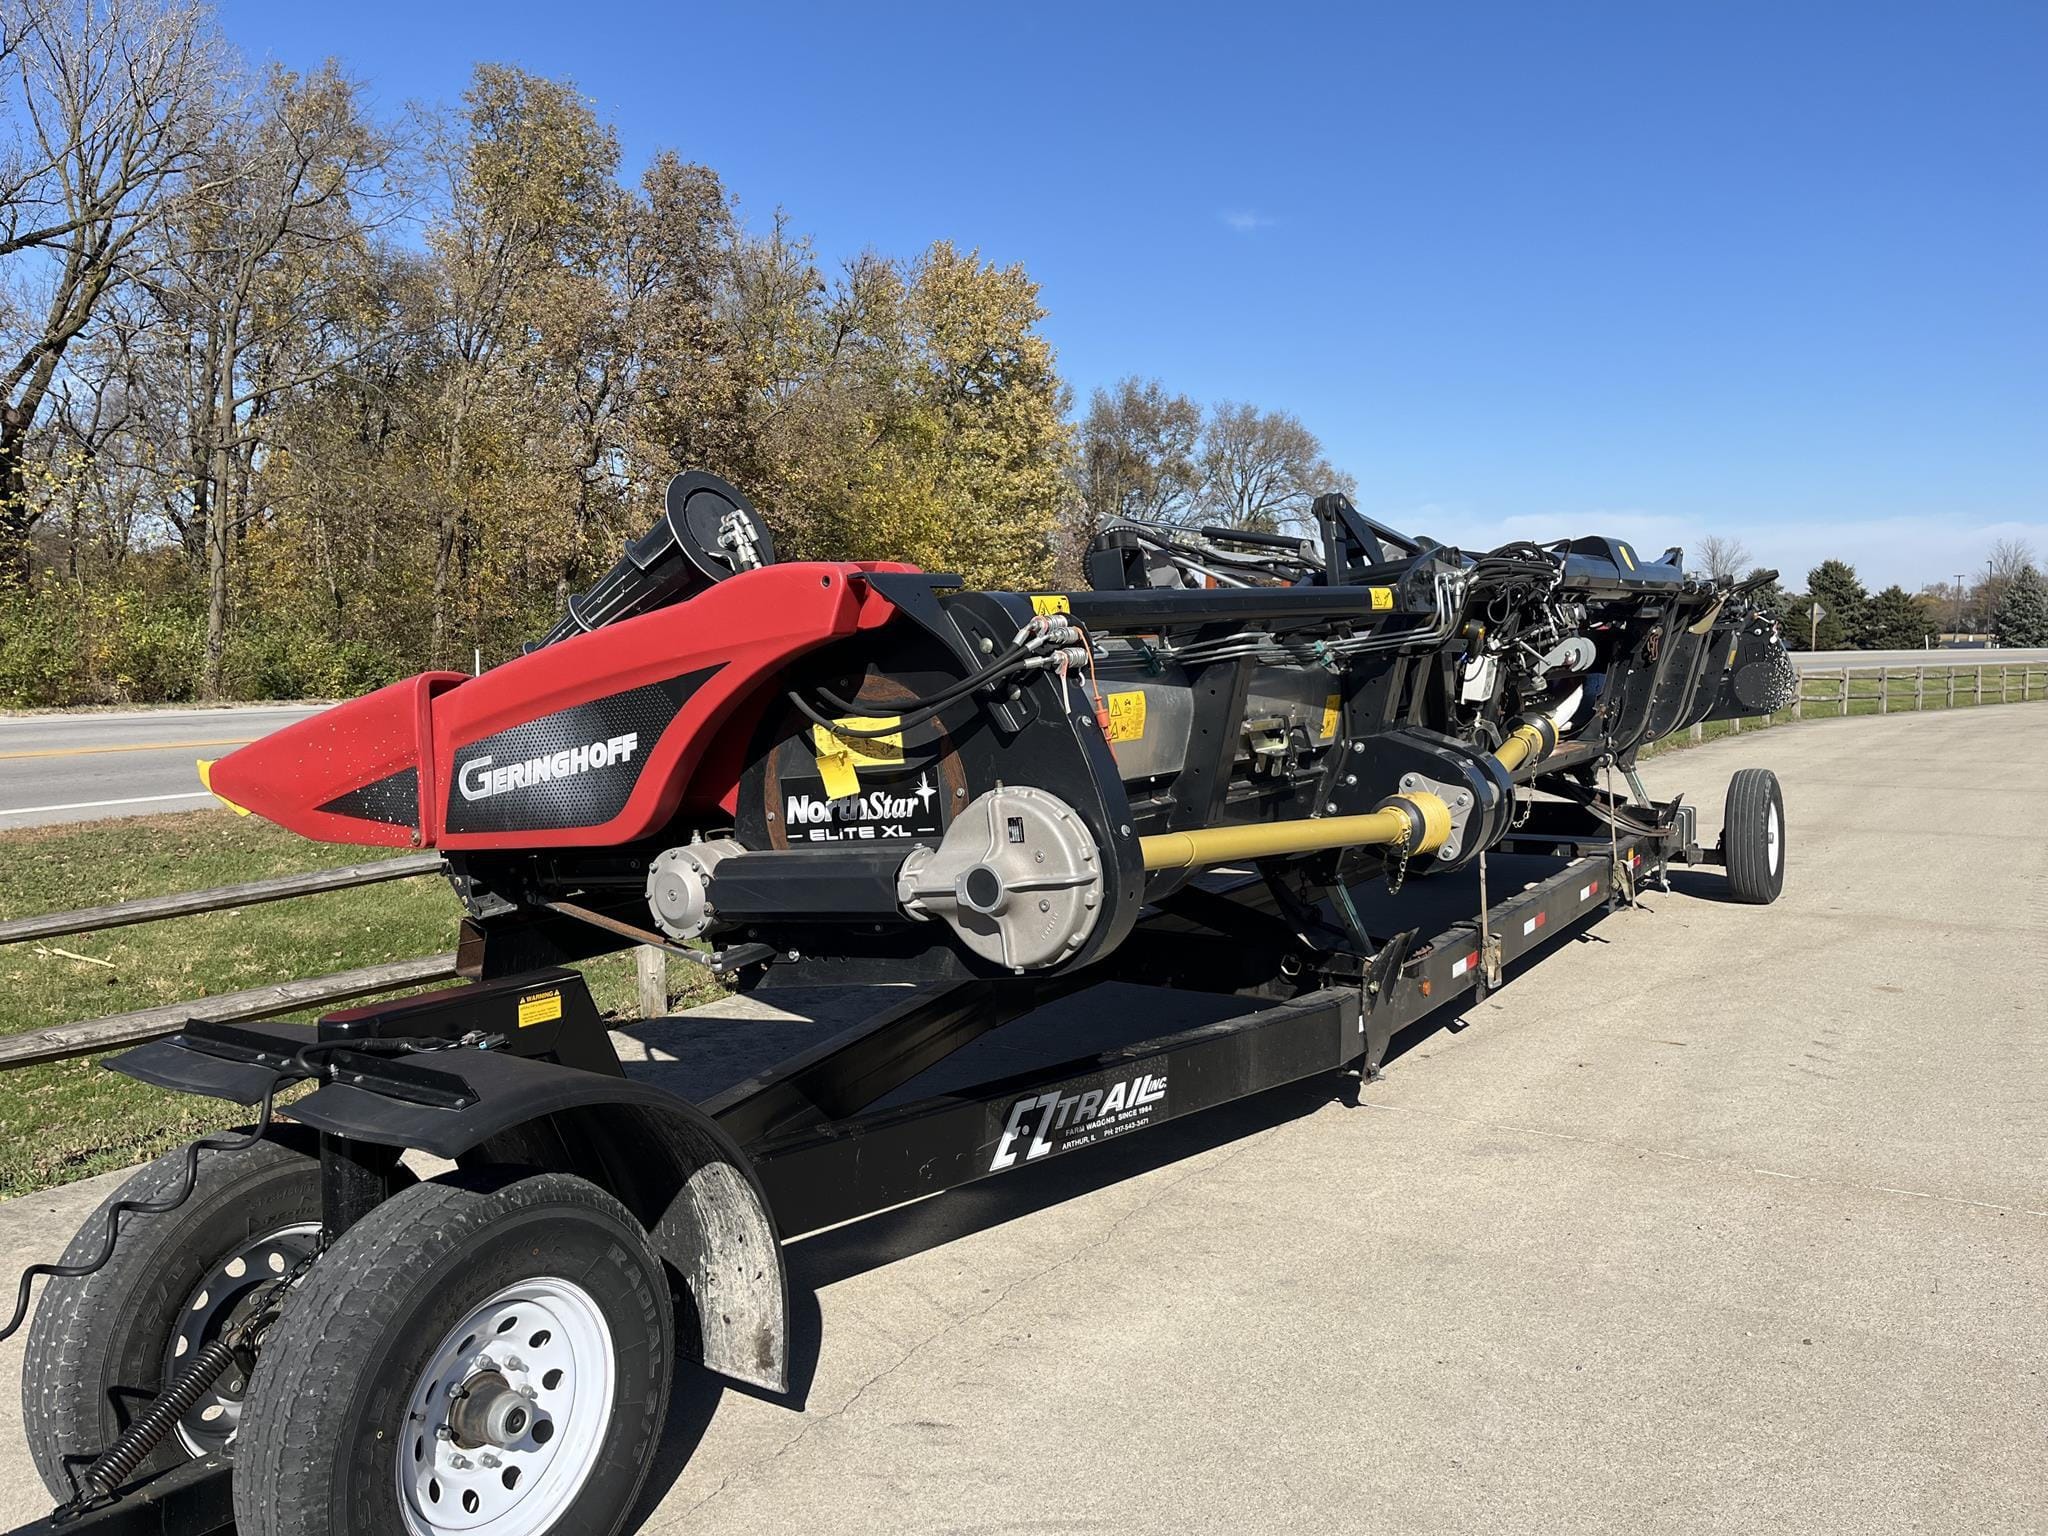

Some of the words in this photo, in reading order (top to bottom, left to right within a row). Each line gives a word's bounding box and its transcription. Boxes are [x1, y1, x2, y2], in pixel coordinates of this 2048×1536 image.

[458, 732, 638, 801] GERINGHOFF
[881, 825, 912, 838] XL
[1065, 1124, 1086, 1137] FARM
[1086, 1115, 1116, 1131] WAGONS
[1118, 1108, 1138, 1121] SINCE
